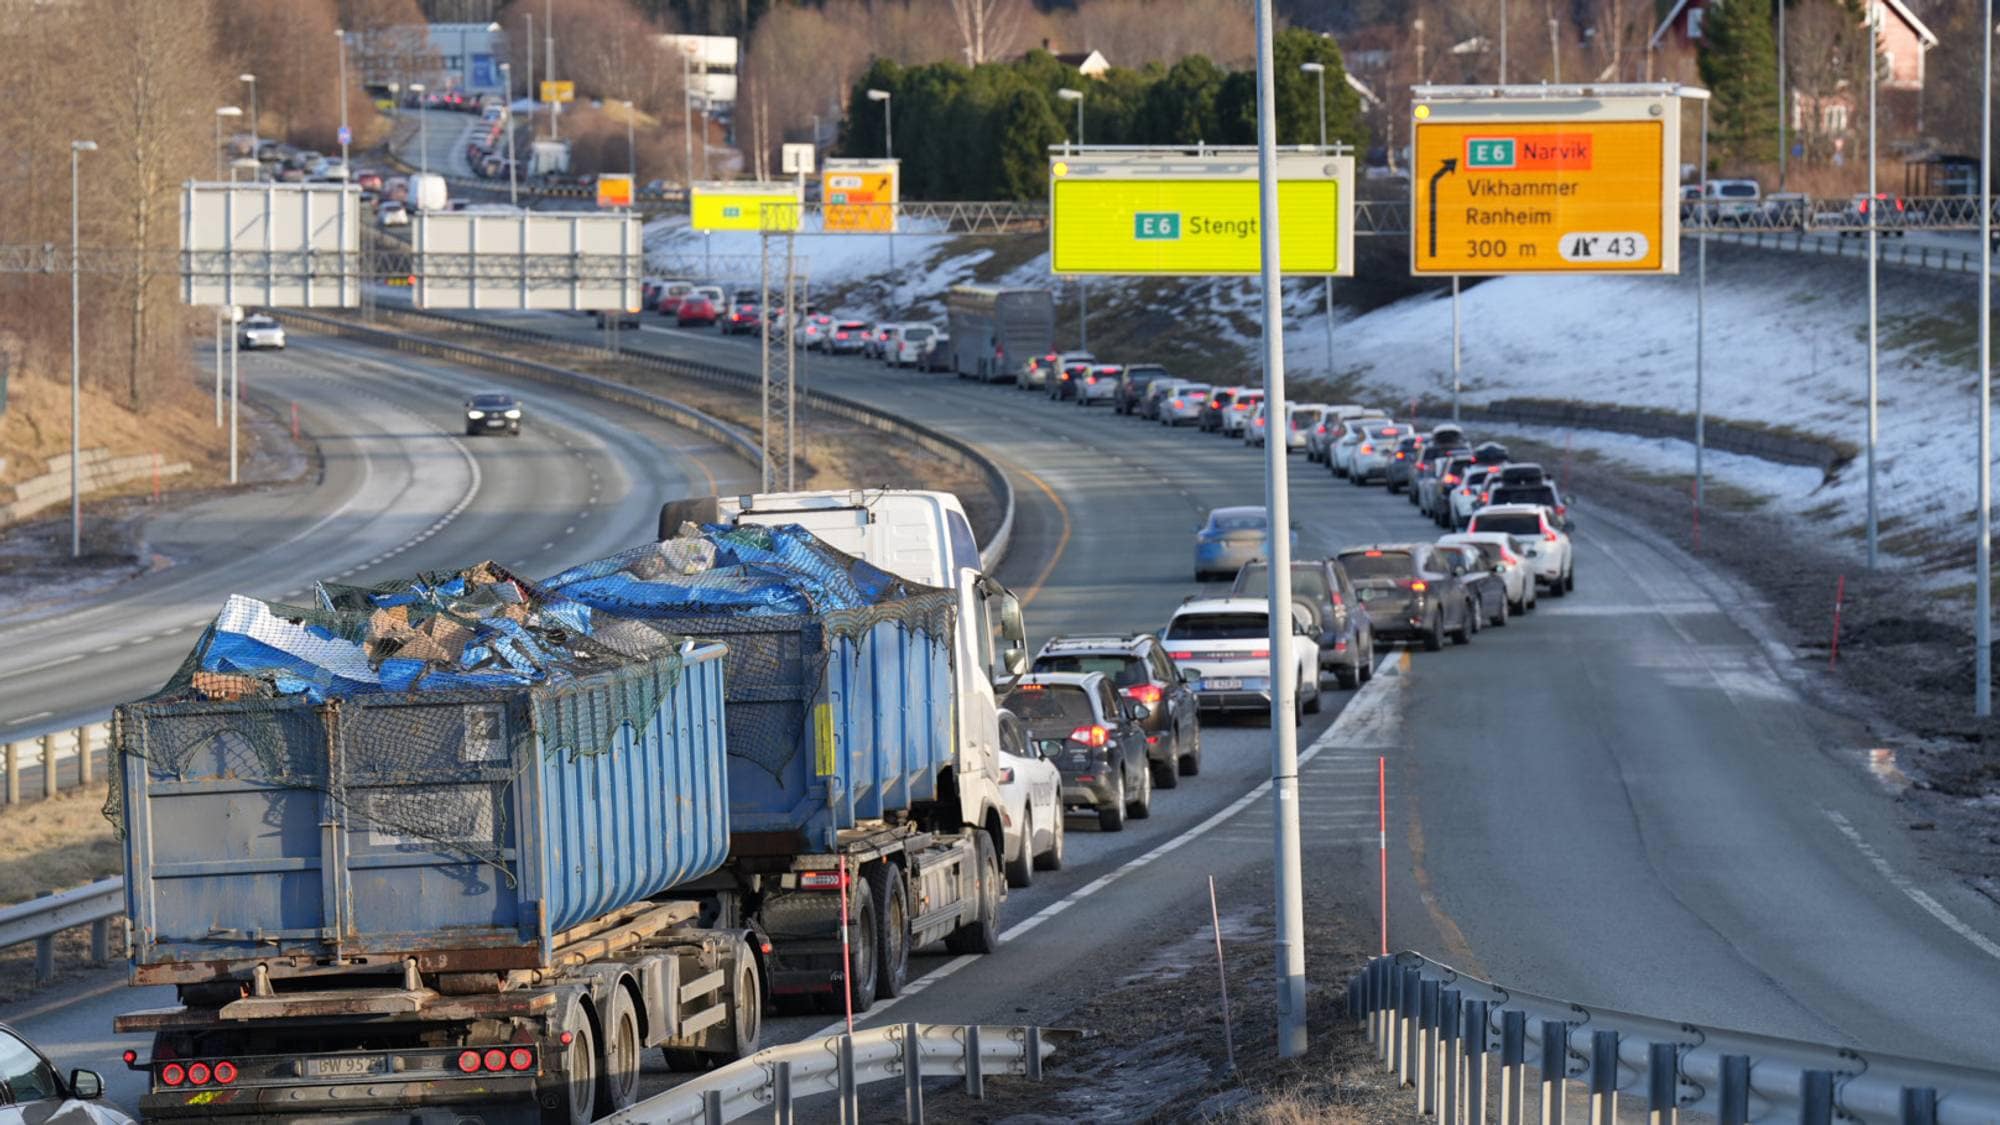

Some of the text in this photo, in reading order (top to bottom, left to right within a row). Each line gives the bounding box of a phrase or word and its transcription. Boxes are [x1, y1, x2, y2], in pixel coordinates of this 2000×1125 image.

[1524, 143, 1587, 160] Narvik
[1467, 179, 1578, 196] Vikhammer
[1466, 207, 1552, 225] Ranheim
[1190, 216, 1257, 239] Stengt
[1467, 240, 1537, 257] 300 m
[1607, 237, 1636, 257] 43
